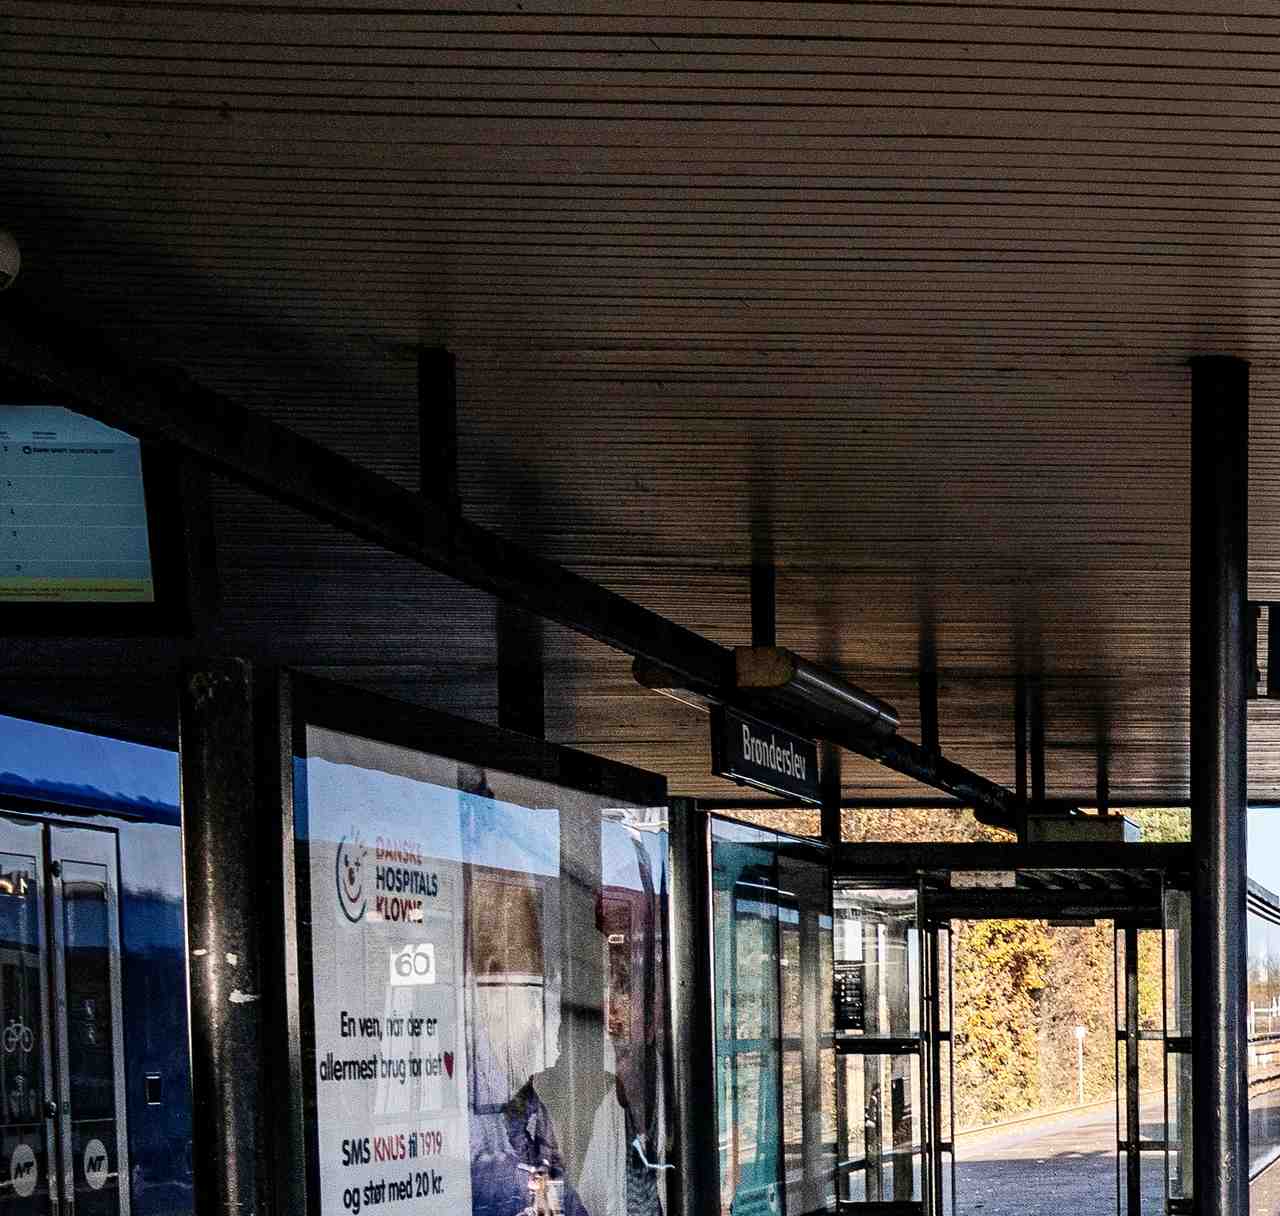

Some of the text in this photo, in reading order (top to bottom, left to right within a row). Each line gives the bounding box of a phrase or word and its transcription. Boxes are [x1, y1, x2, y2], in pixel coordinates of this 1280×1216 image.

[376, 836, 422, 864] DANSKE
[376, 865, 438, 897] HOSPITALS
[376, 895, 423, 924] KLOVNE
[340, 1011, 356, 1037] En
[359, 1015, 382, 1041] ven,
[407, 1011, 424, 1037] der
[426, 1018, 438, 1036] er
[320, 1051, 442, 1085] allermest brug for det
[88, 1155, 105, 1172] NT
[342, 1131, 442, 1167] SMS KNUS til 1919
[343, 1169, 444, 1215] og støt med 20 kr.
